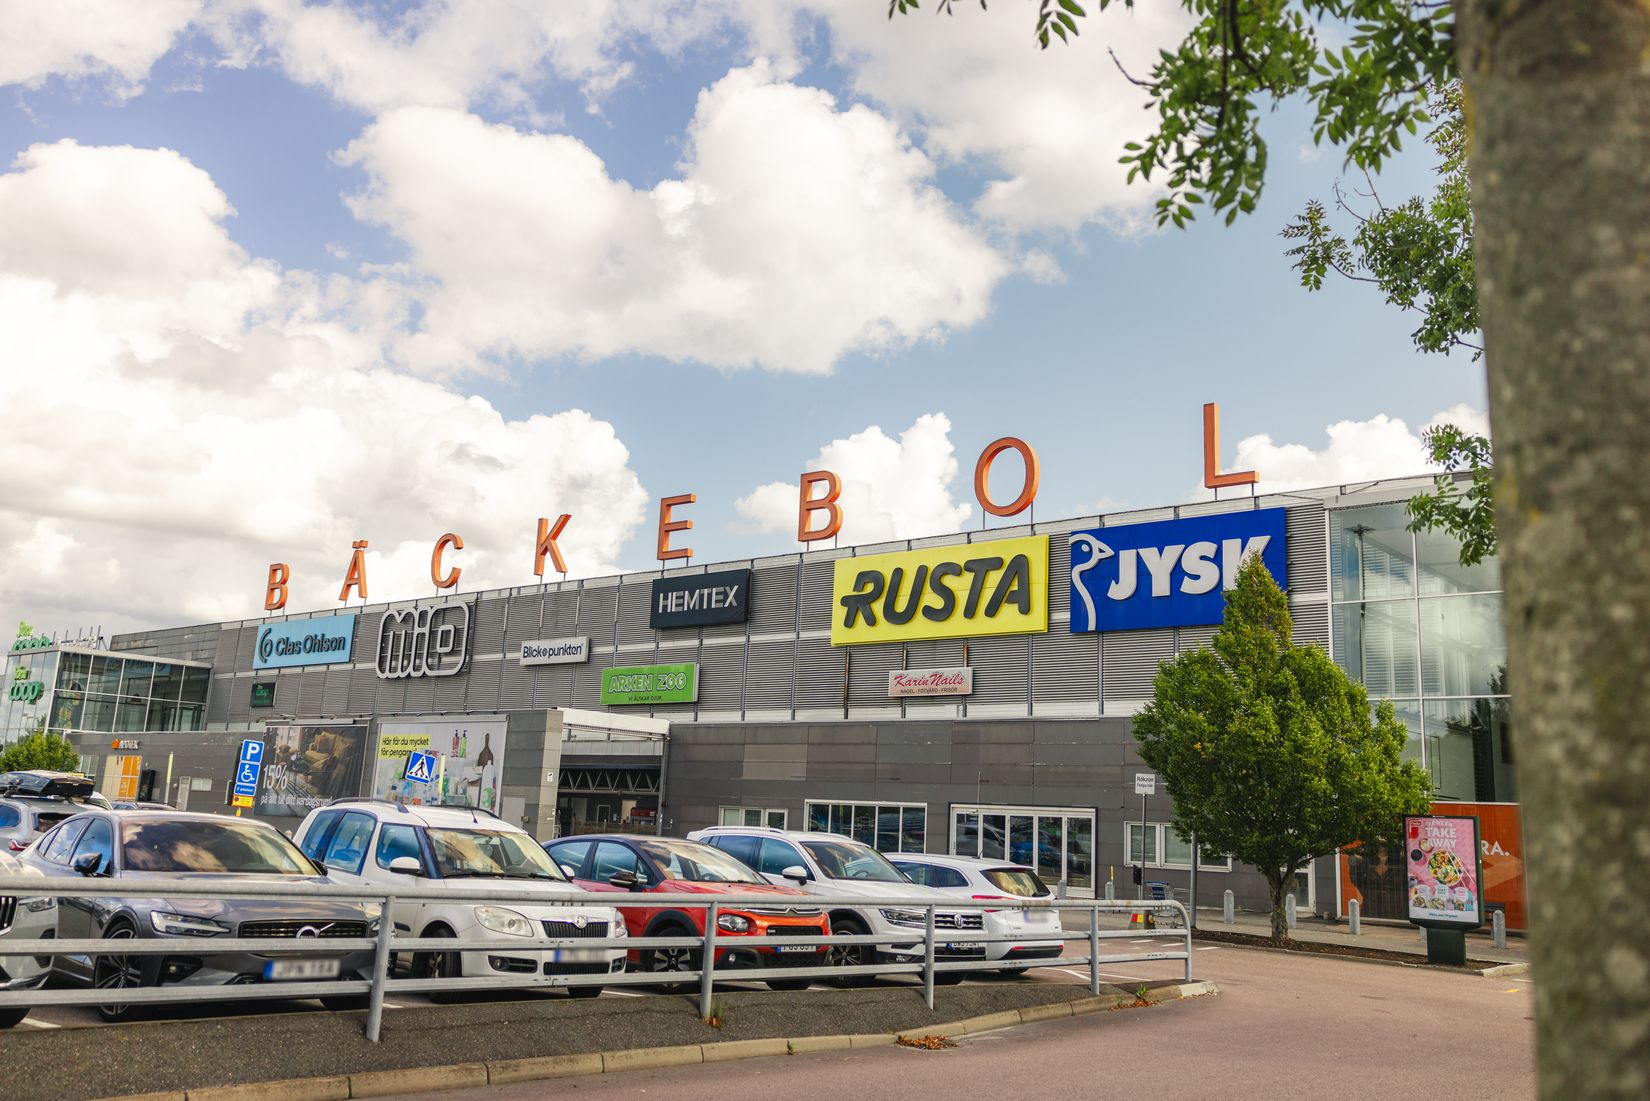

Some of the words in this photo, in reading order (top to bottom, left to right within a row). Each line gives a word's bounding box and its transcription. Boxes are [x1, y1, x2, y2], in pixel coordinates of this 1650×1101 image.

[1107, 535, 1271, 600] JYSK
[658, 585, 739, 613] HEMTEX
[840, 553, 1030, 628] RUSTA
[275, 637, 302, 656] Clas
[303, 633, 346, 654] Ohlson
[608, 673, 653, 694] ARKEN
[656, 671, 688, 691] ZOO
[894, 674, 928, 687] Karin
[930, 671, 965, 687] Nails
[8, 681, 44, 705] coop
[246, 742, 260, 760] P
[400, 737, 408, 745] du
[409, 737, 429, 749] mycket
[263, 764, 287, 789] 15%
[261, 793, 268, 805] på
[285, 794, 296, 805] ditt
[1425, 828, 1457, 838] TAKE
[1427, 838, 1457, 849] AWAY
